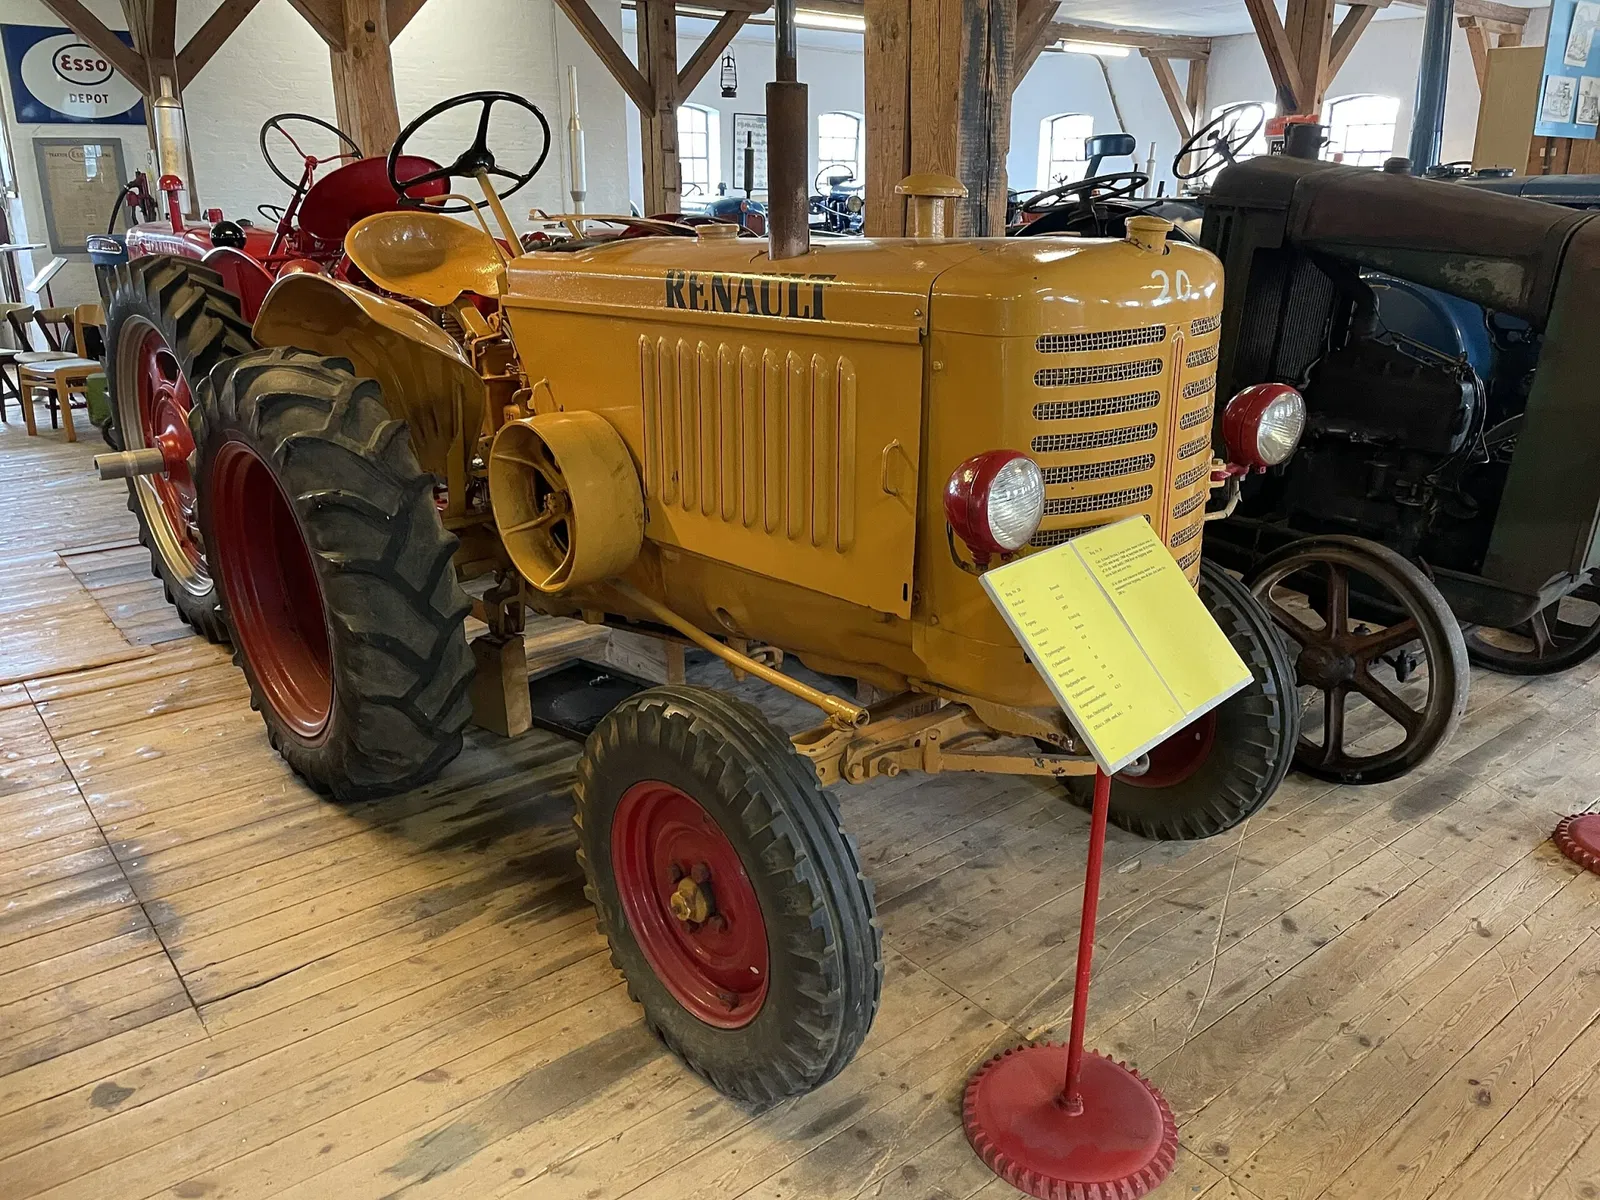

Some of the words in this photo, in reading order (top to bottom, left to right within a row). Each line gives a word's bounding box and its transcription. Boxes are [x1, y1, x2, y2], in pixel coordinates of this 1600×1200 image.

[61, 54, 108, 72] Esso
[69, 93, 109, 104] DEPOT
[665, 268, 837, 321] RENAULT
[1151, 269, 1191, 307] 20
